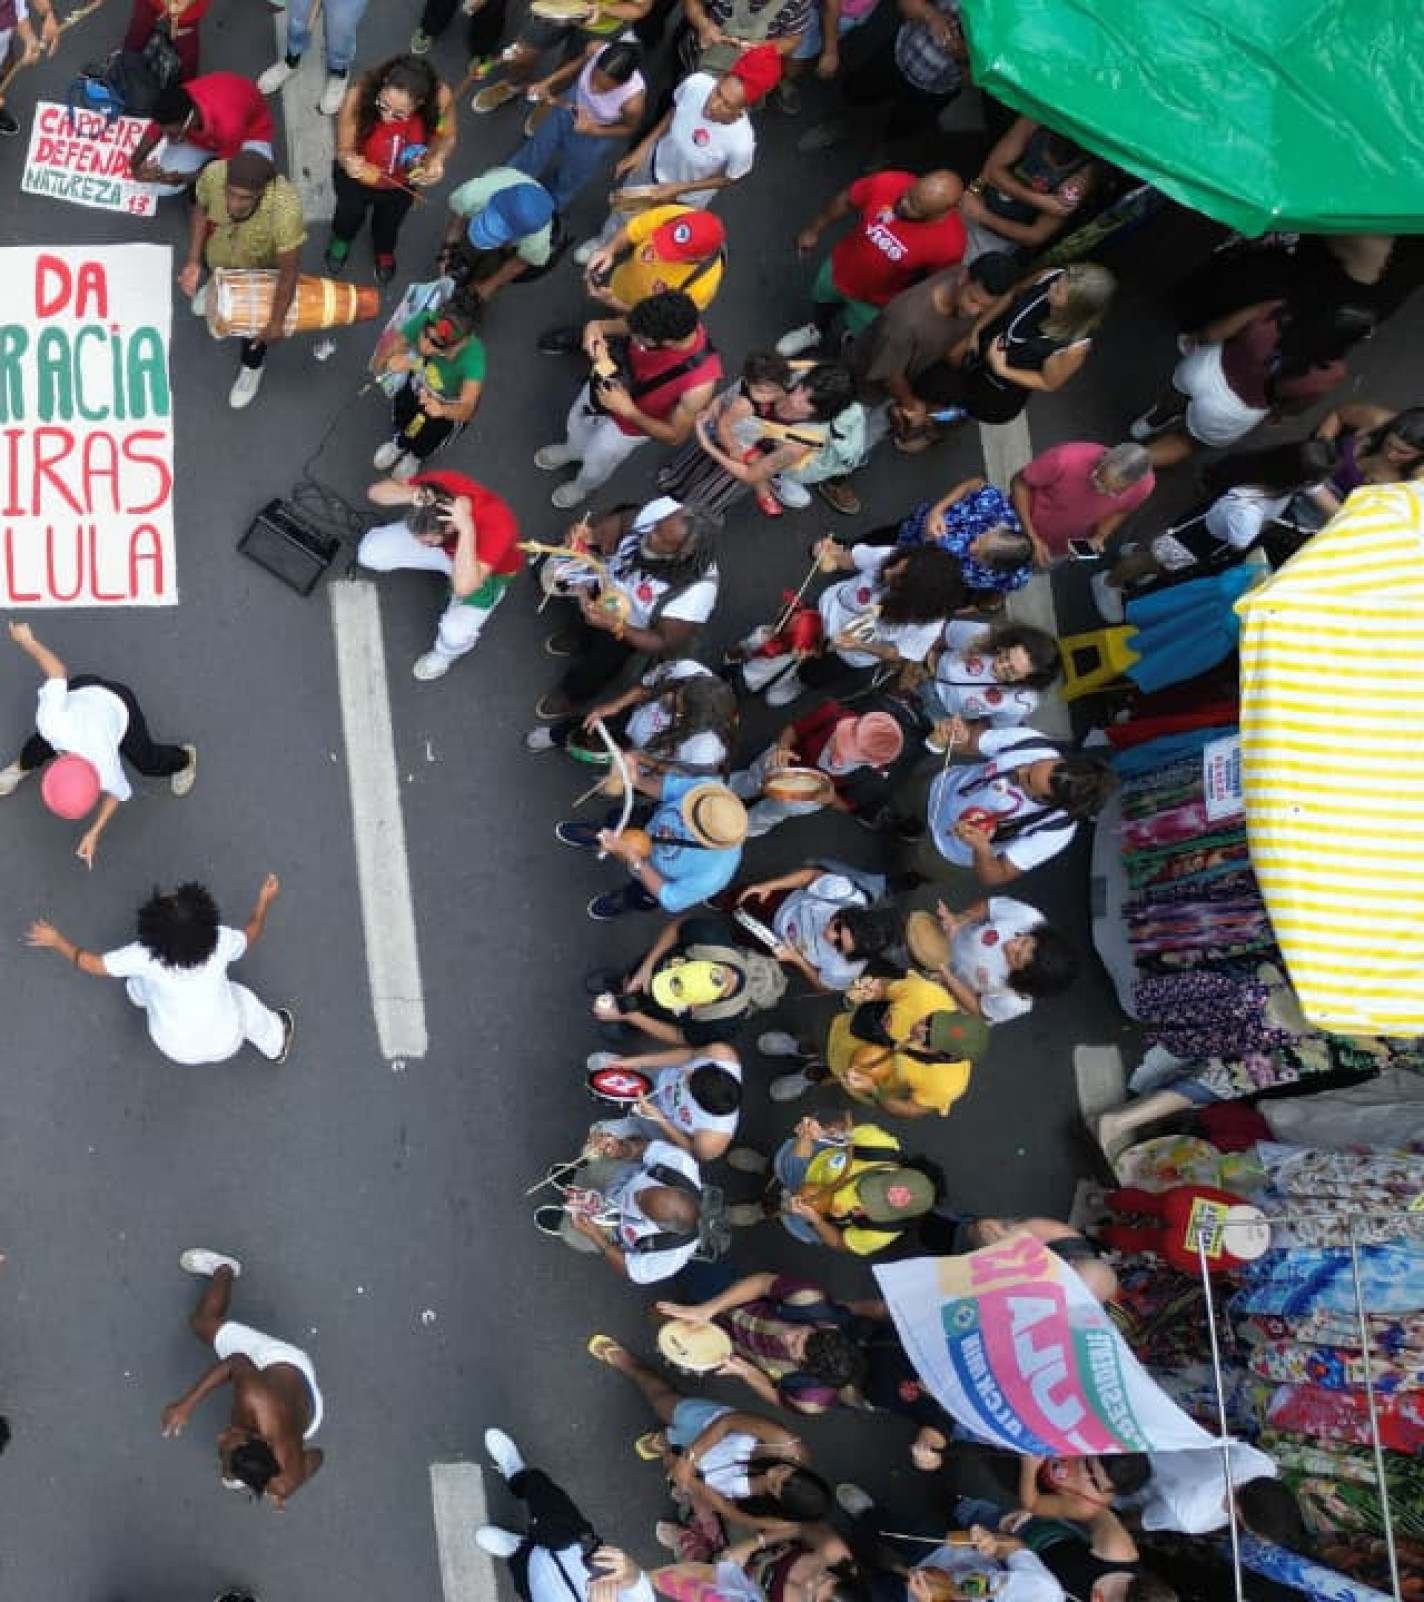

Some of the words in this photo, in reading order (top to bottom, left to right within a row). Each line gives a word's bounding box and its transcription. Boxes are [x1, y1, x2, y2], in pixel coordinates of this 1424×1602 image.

[39, 107, 146, 150] CAPOEIR
[26, 168, 122, 206] NATUREZA
[127, 192, 150, 213] 13
[34, 253, 108, 319] DA
[4, 522, 165, 602] LULA
